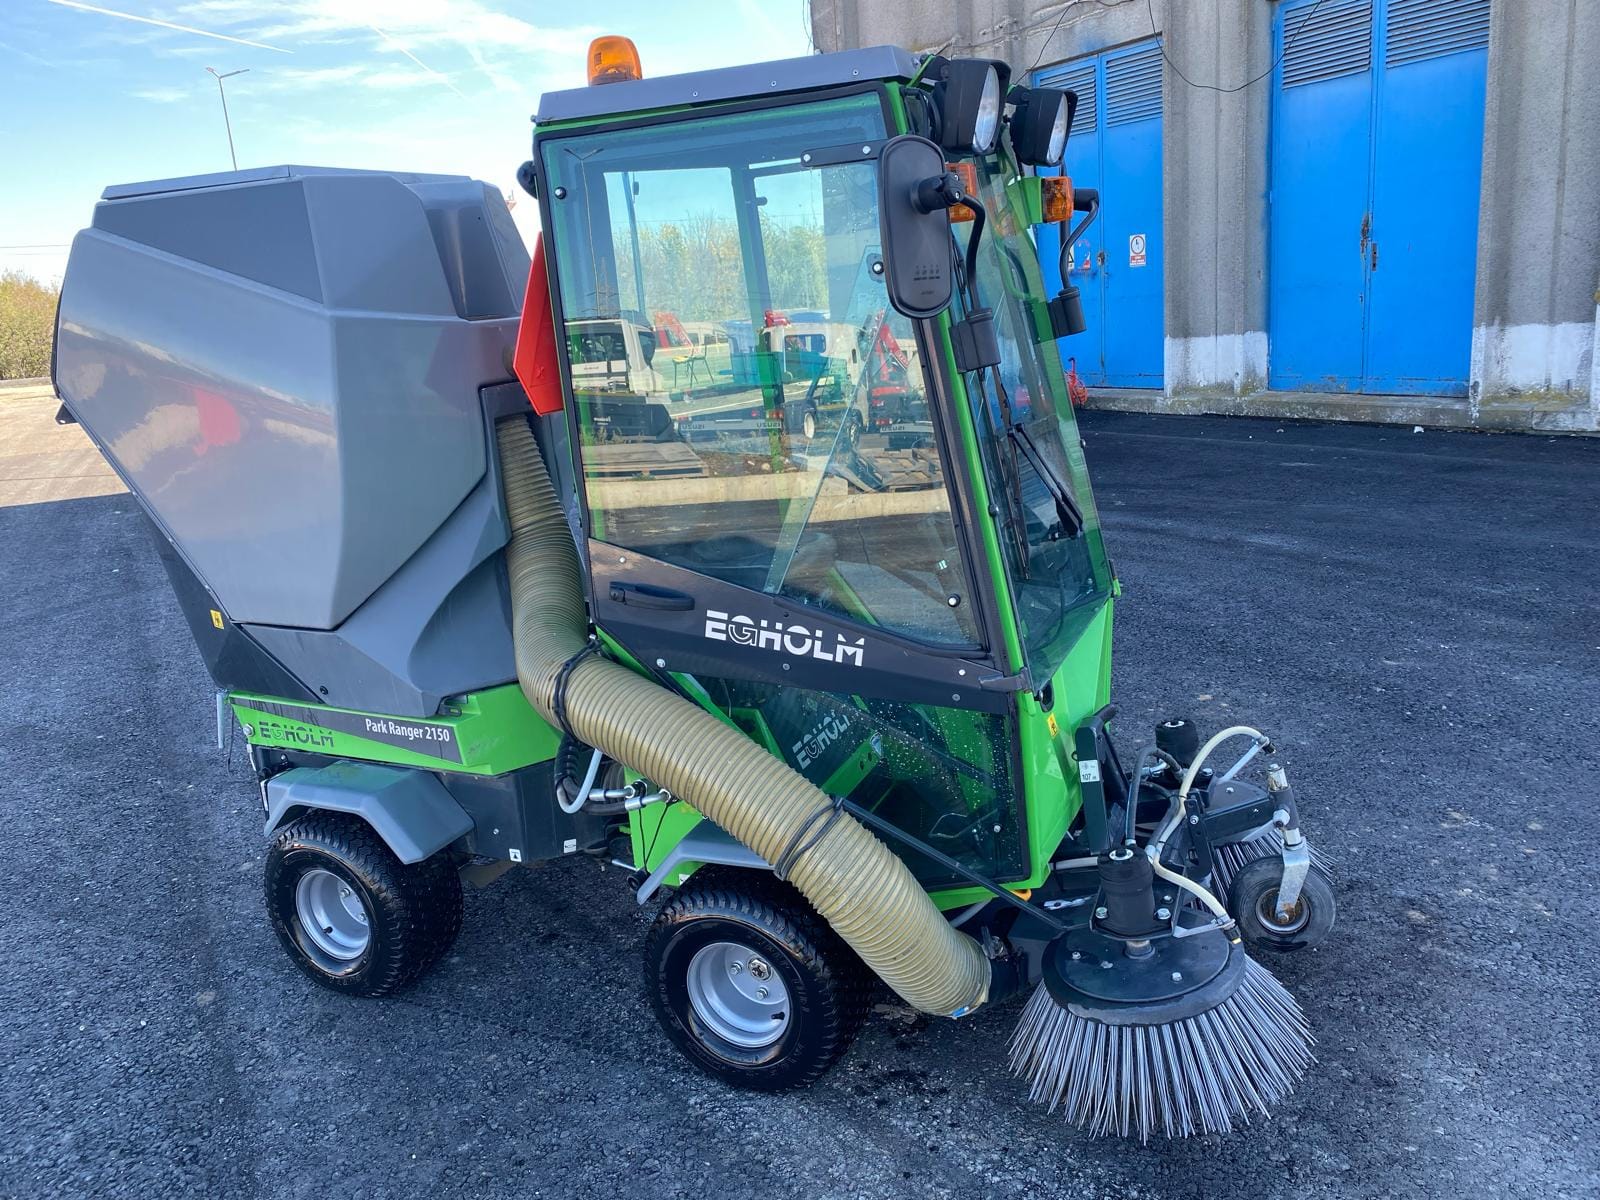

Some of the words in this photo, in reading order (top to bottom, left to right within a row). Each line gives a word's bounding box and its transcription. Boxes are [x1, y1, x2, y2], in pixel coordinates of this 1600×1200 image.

[705, 609, 865, 667] EGHOLM
[259, 721, 334, 748] EGHOLM
[365, 718, 388, 734] Park
[388, 721, 423, 740] Ranger
[424, 726, 450, 742] 2150
[1081, 772, 1091, 781] 107
